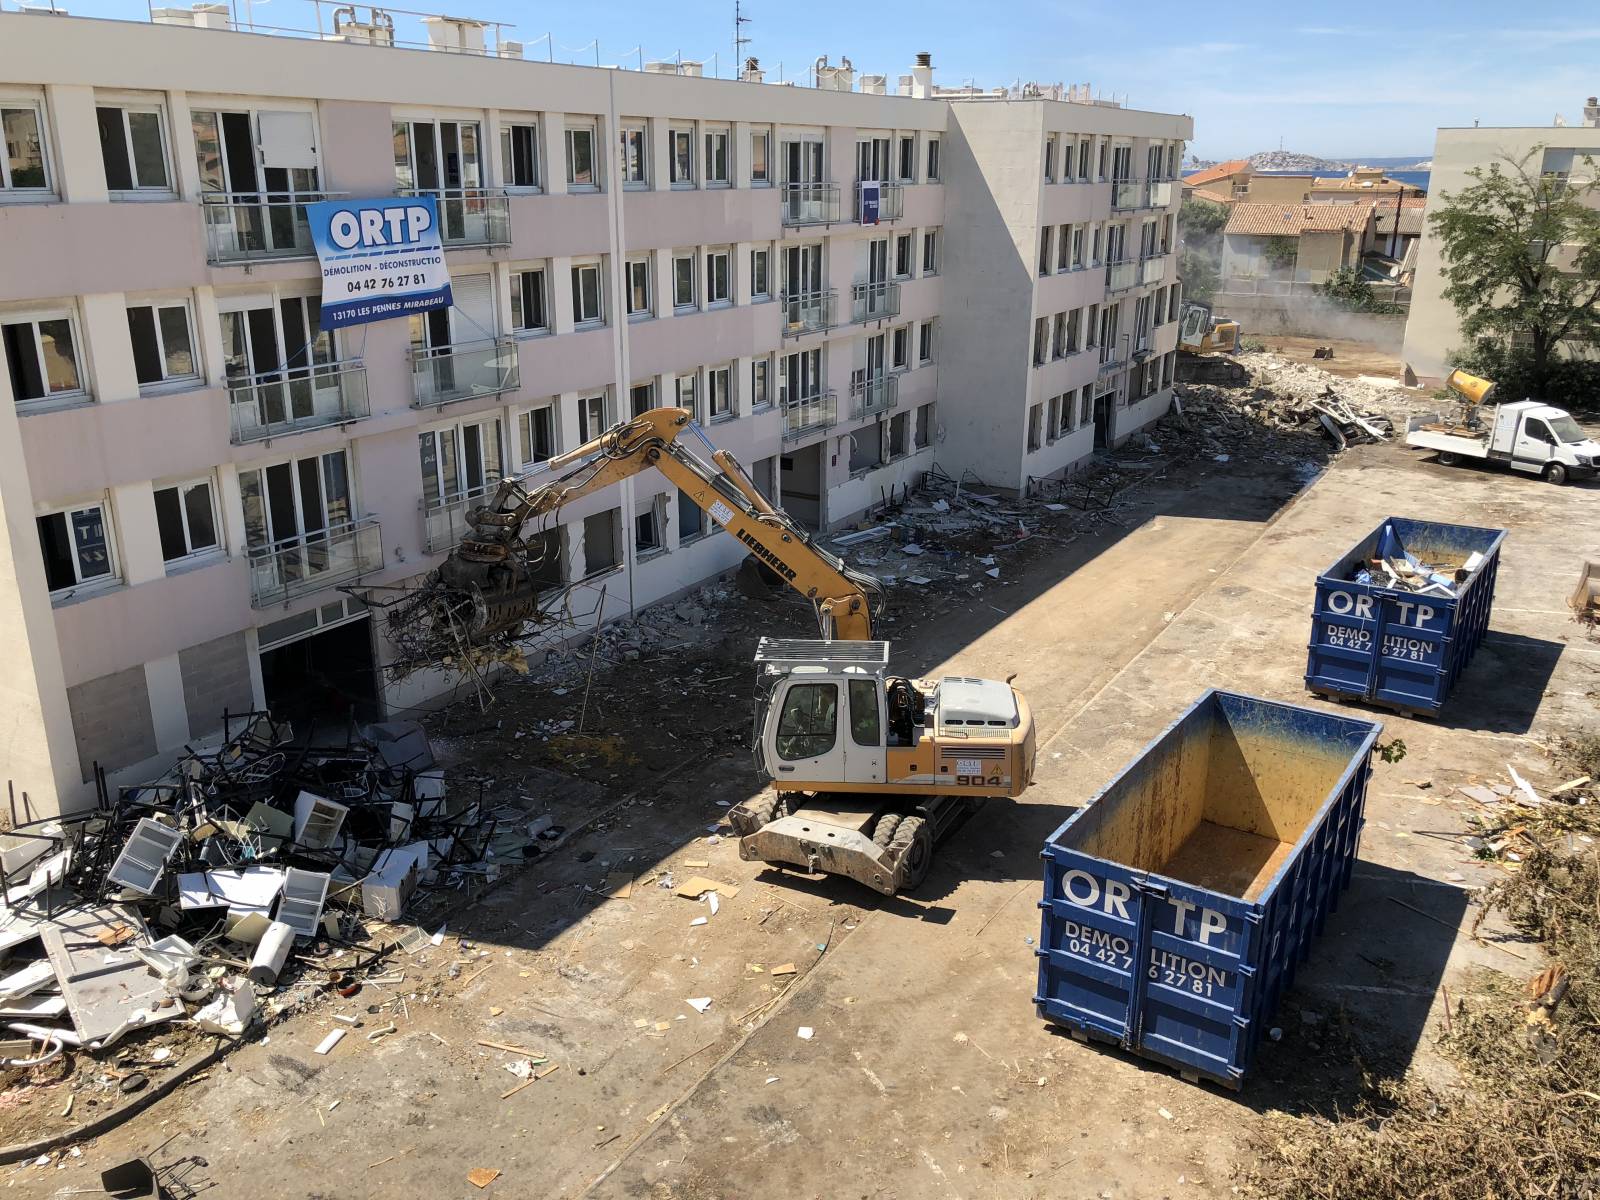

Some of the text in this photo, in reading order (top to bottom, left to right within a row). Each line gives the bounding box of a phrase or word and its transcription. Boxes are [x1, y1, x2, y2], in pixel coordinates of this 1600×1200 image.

[330, 205, 431, 249] ORTP
[324, 263, 371, 276] DÉMOLITION
[348, 274, 426, 292] 04 42 76 27 81
[333, 296, 444, 320] 13170 LES PENNES MIRABEAU
[736, 528, 797, 582] LIEBHERR
[1328, 625, 1432, 653] DEMO LITION
[1330, 636, 1344, 646] 04
[1347, 640, 1360, 649] 42
[1392, 648, 1407, 657] 27
[1410, 651, 1424, 660] 81
[956, 775, 1001, 786] 904
[1065, 920, 1226, 987] DEMO LITION
[1070, 939, 1090, 957] 04
[1095, 949, 1116, 965] 42
[1165, 970, 1186, 987] 27
[1192, 980, 1212, 997] 81
